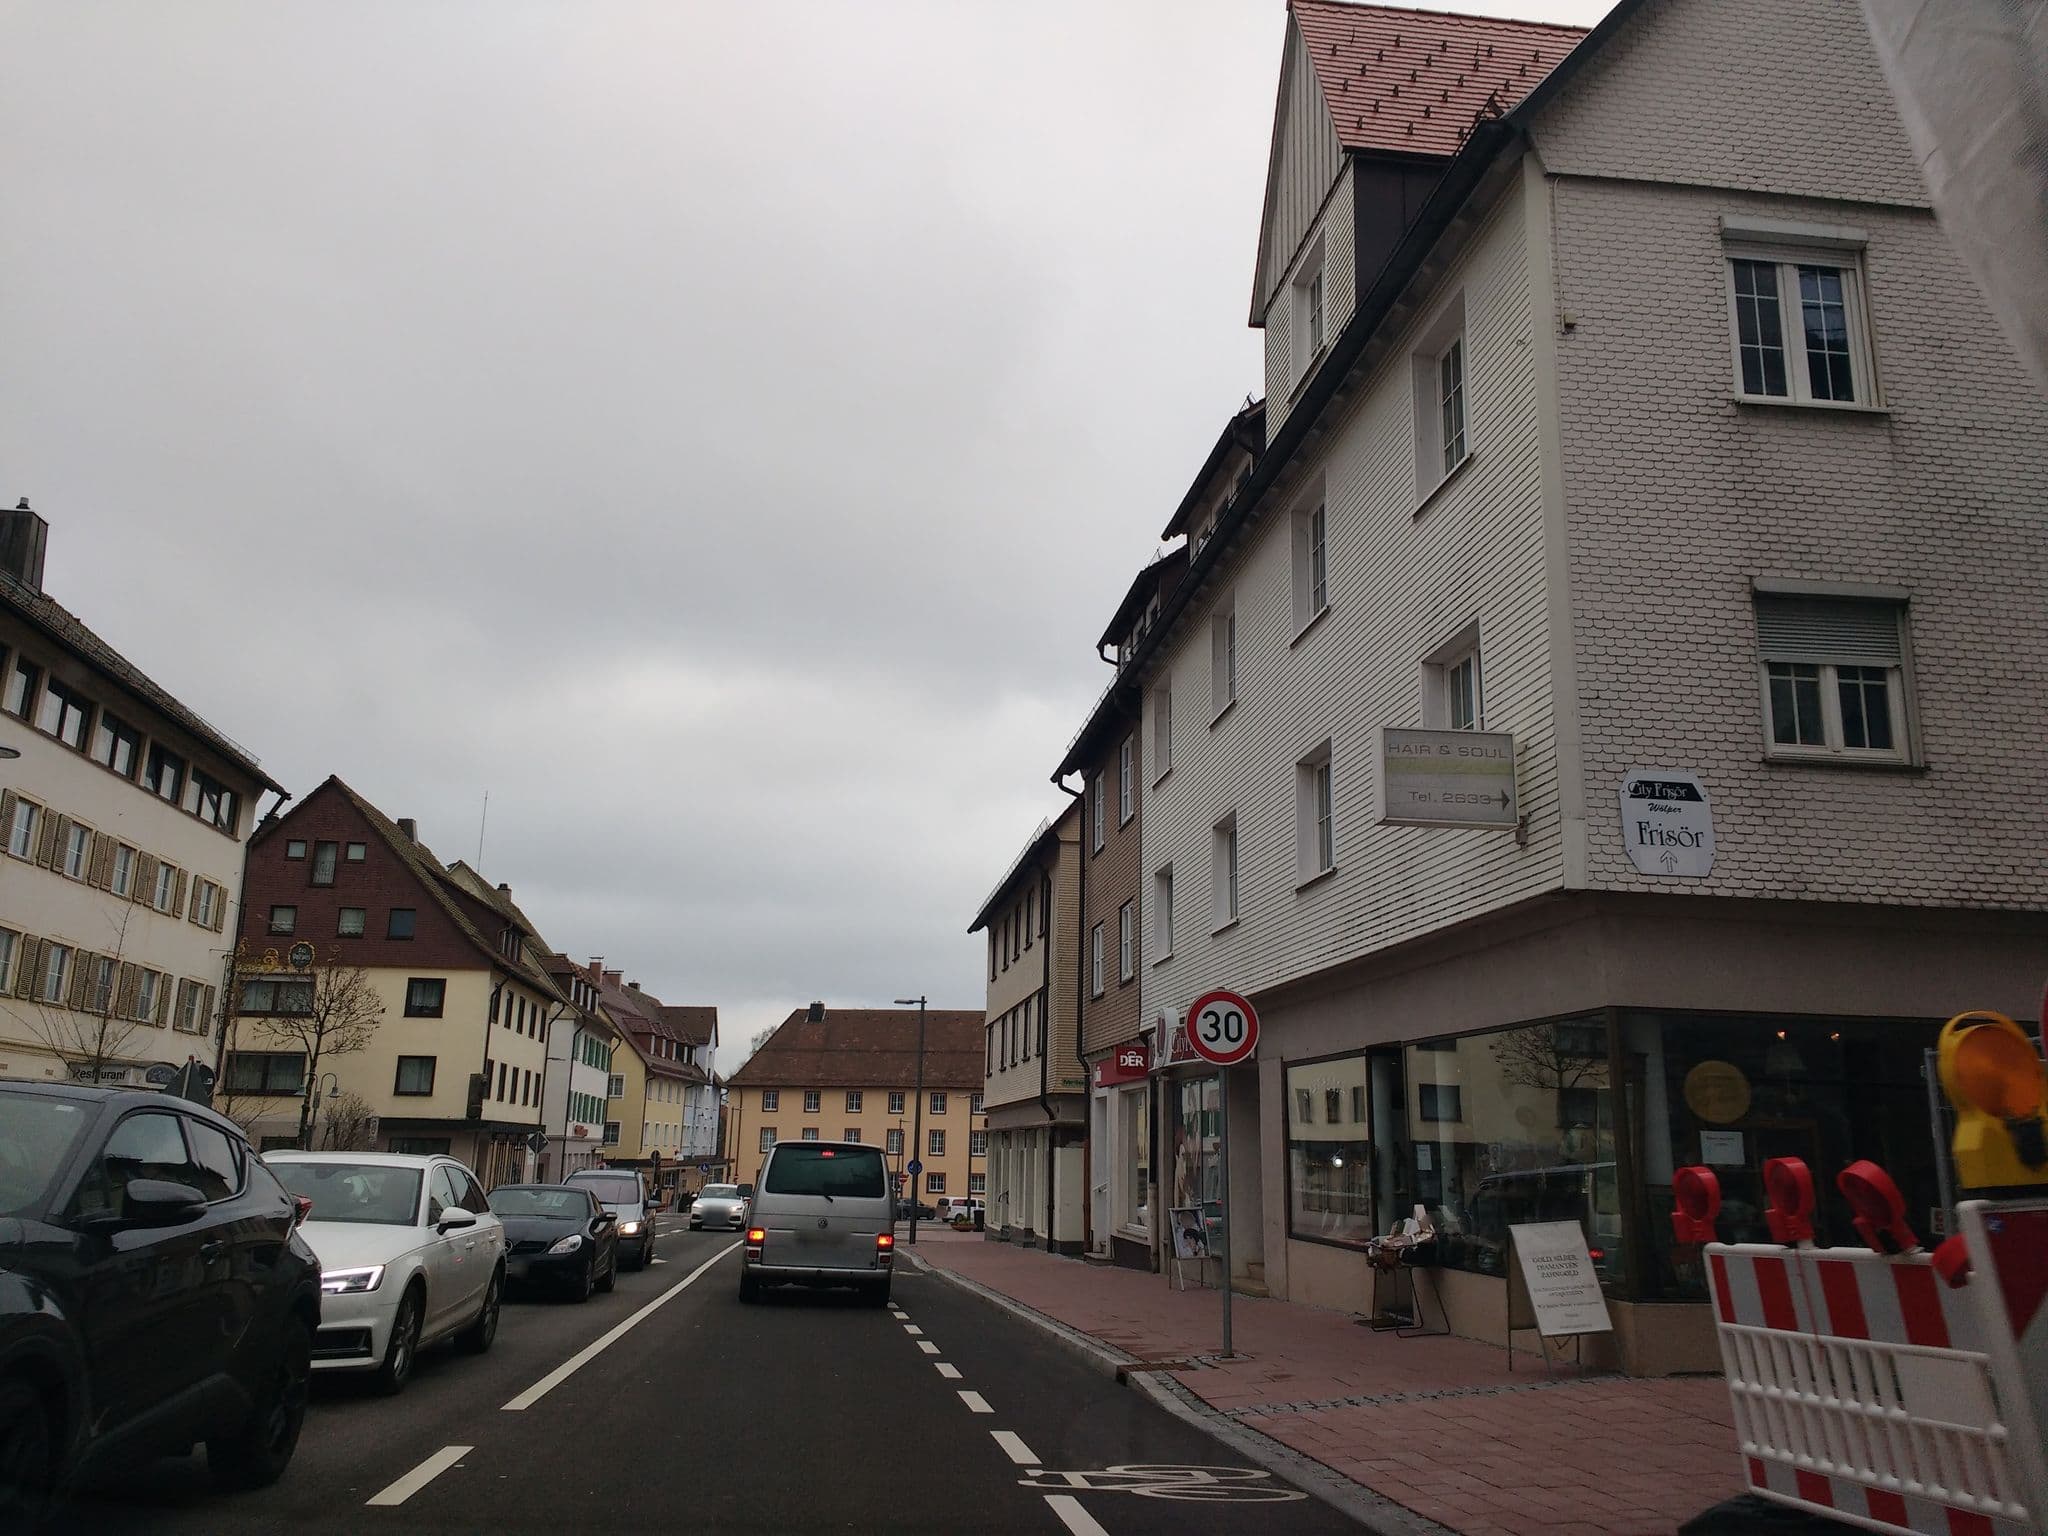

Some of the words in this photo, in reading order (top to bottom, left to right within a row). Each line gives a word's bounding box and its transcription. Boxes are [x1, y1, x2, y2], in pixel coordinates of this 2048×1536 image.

[1388, 743, 1431, 755] HAIR
[1439, 745, 1451, 755] &
[1458, 746, 1509, 759] SOUL
[1408, 791, 1437, 802] Tel.
[1442, 792, 1491, 805] 2633
[1628, 782, 1652, 799] City
[1654, 783, 1688, 800] Frisör
[1636, 821, 1704, 848] Frisör
[1202, 1010, 1243, 1043] 30
[1120, 1054, 1145, 1067] DER
[72, 1068, 127, 1080] Resturant
